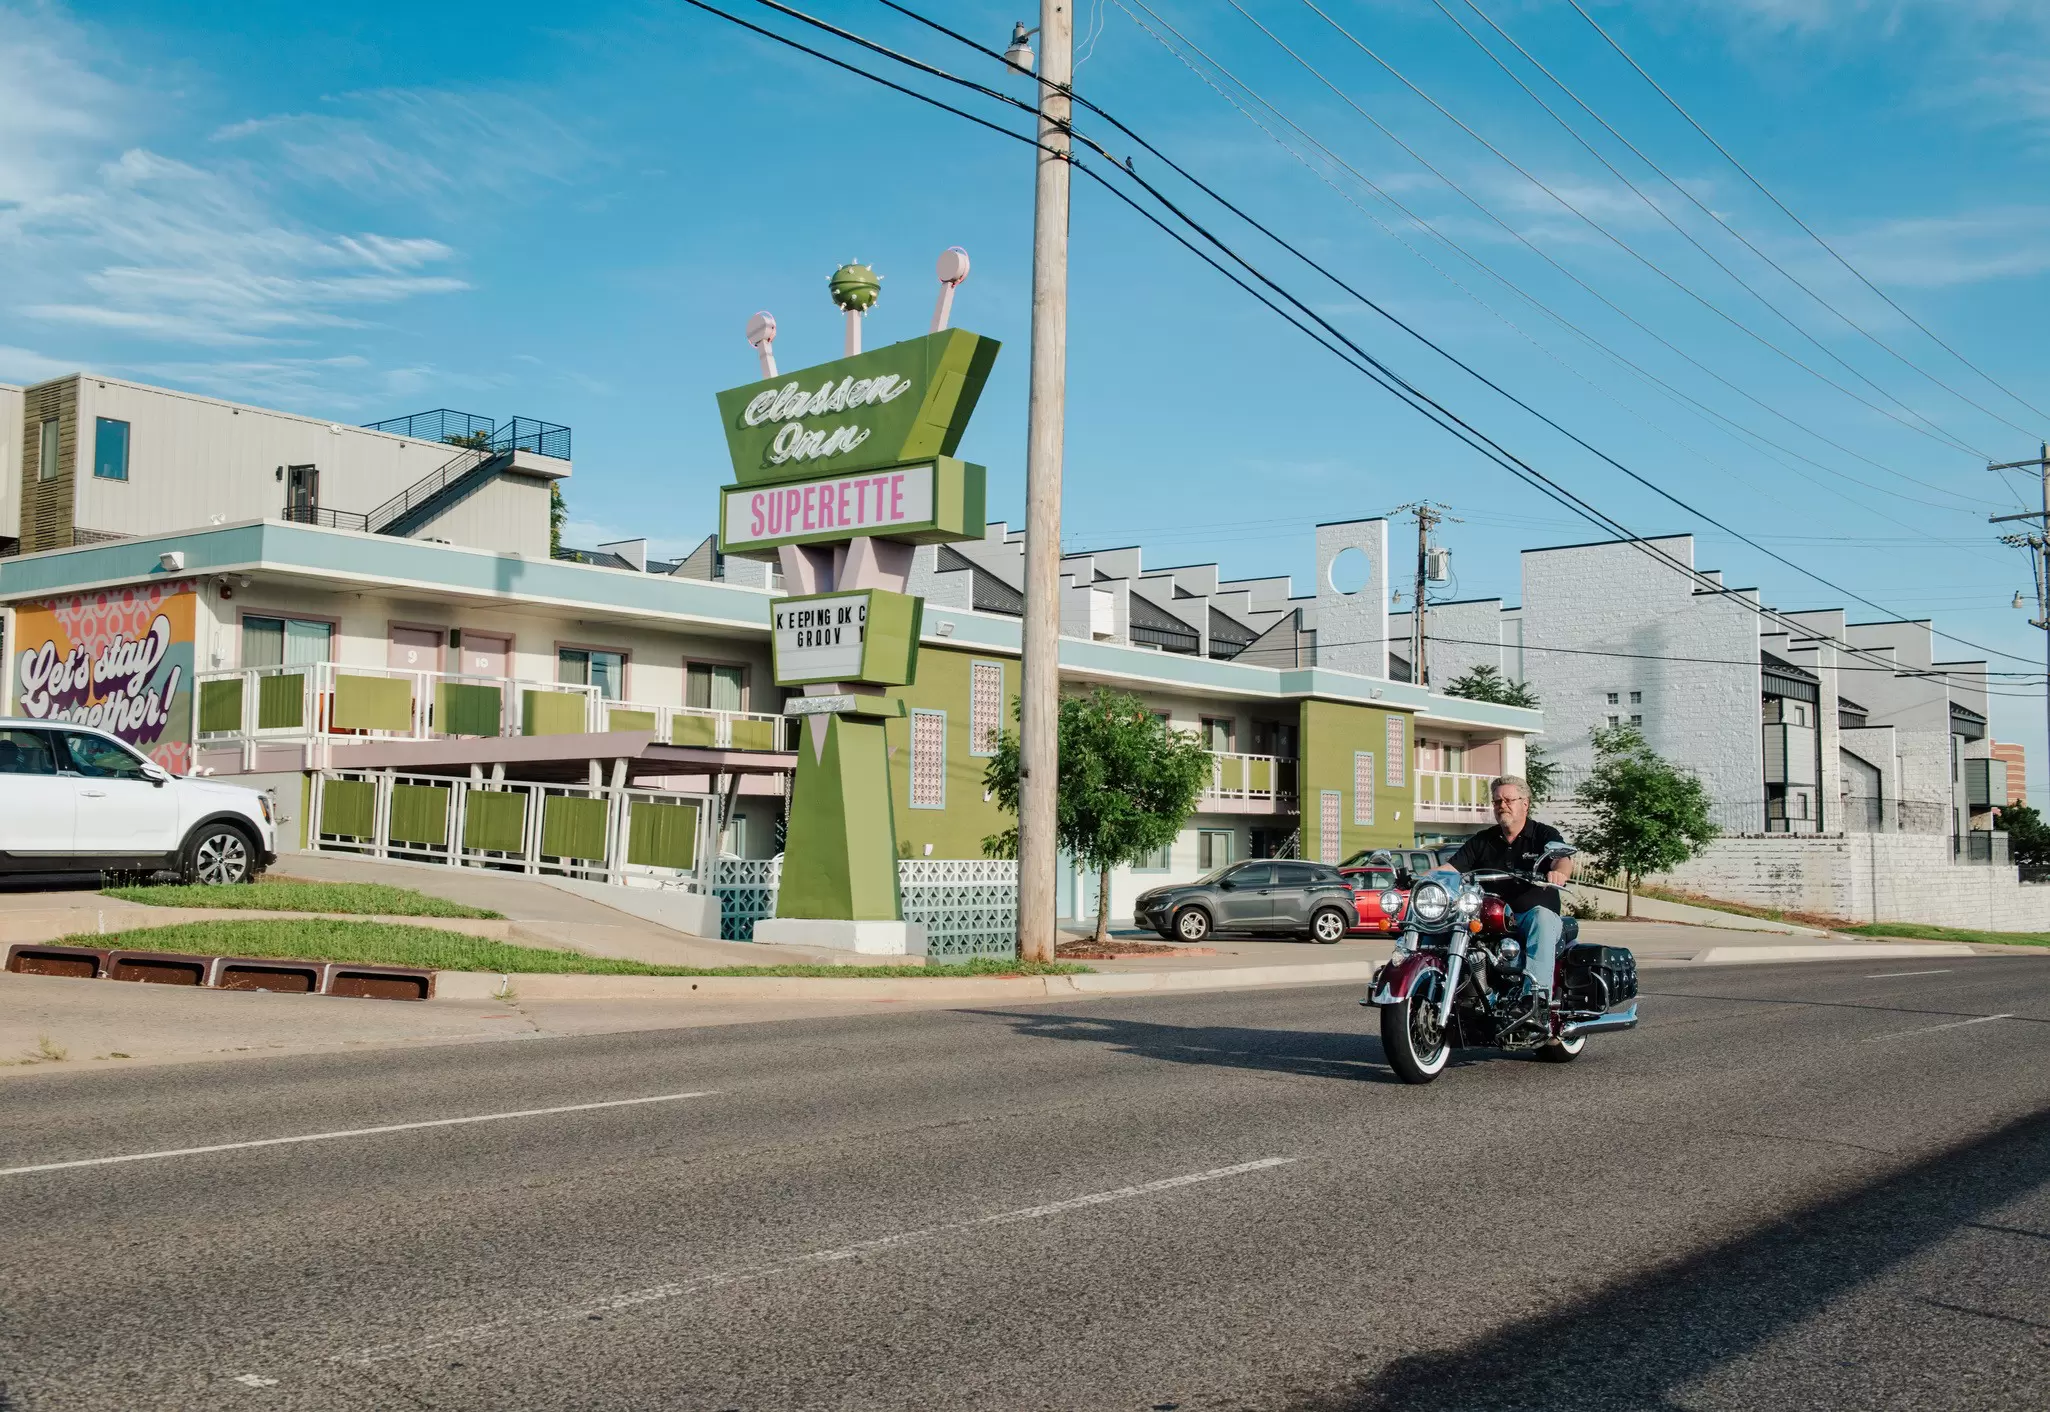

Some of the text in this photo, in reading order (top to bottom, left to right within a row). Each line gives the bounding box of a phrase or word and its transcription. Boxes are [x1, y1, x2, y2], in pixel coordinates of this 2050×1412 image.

[745, 374, 911, 426] Classen
[770, 422, 870, 464] Inn
[751, 475, 904, 536] SUPERETTE
[20, 614, 170, 718] Let's stay
[48, 665, 182, 733] ether!
